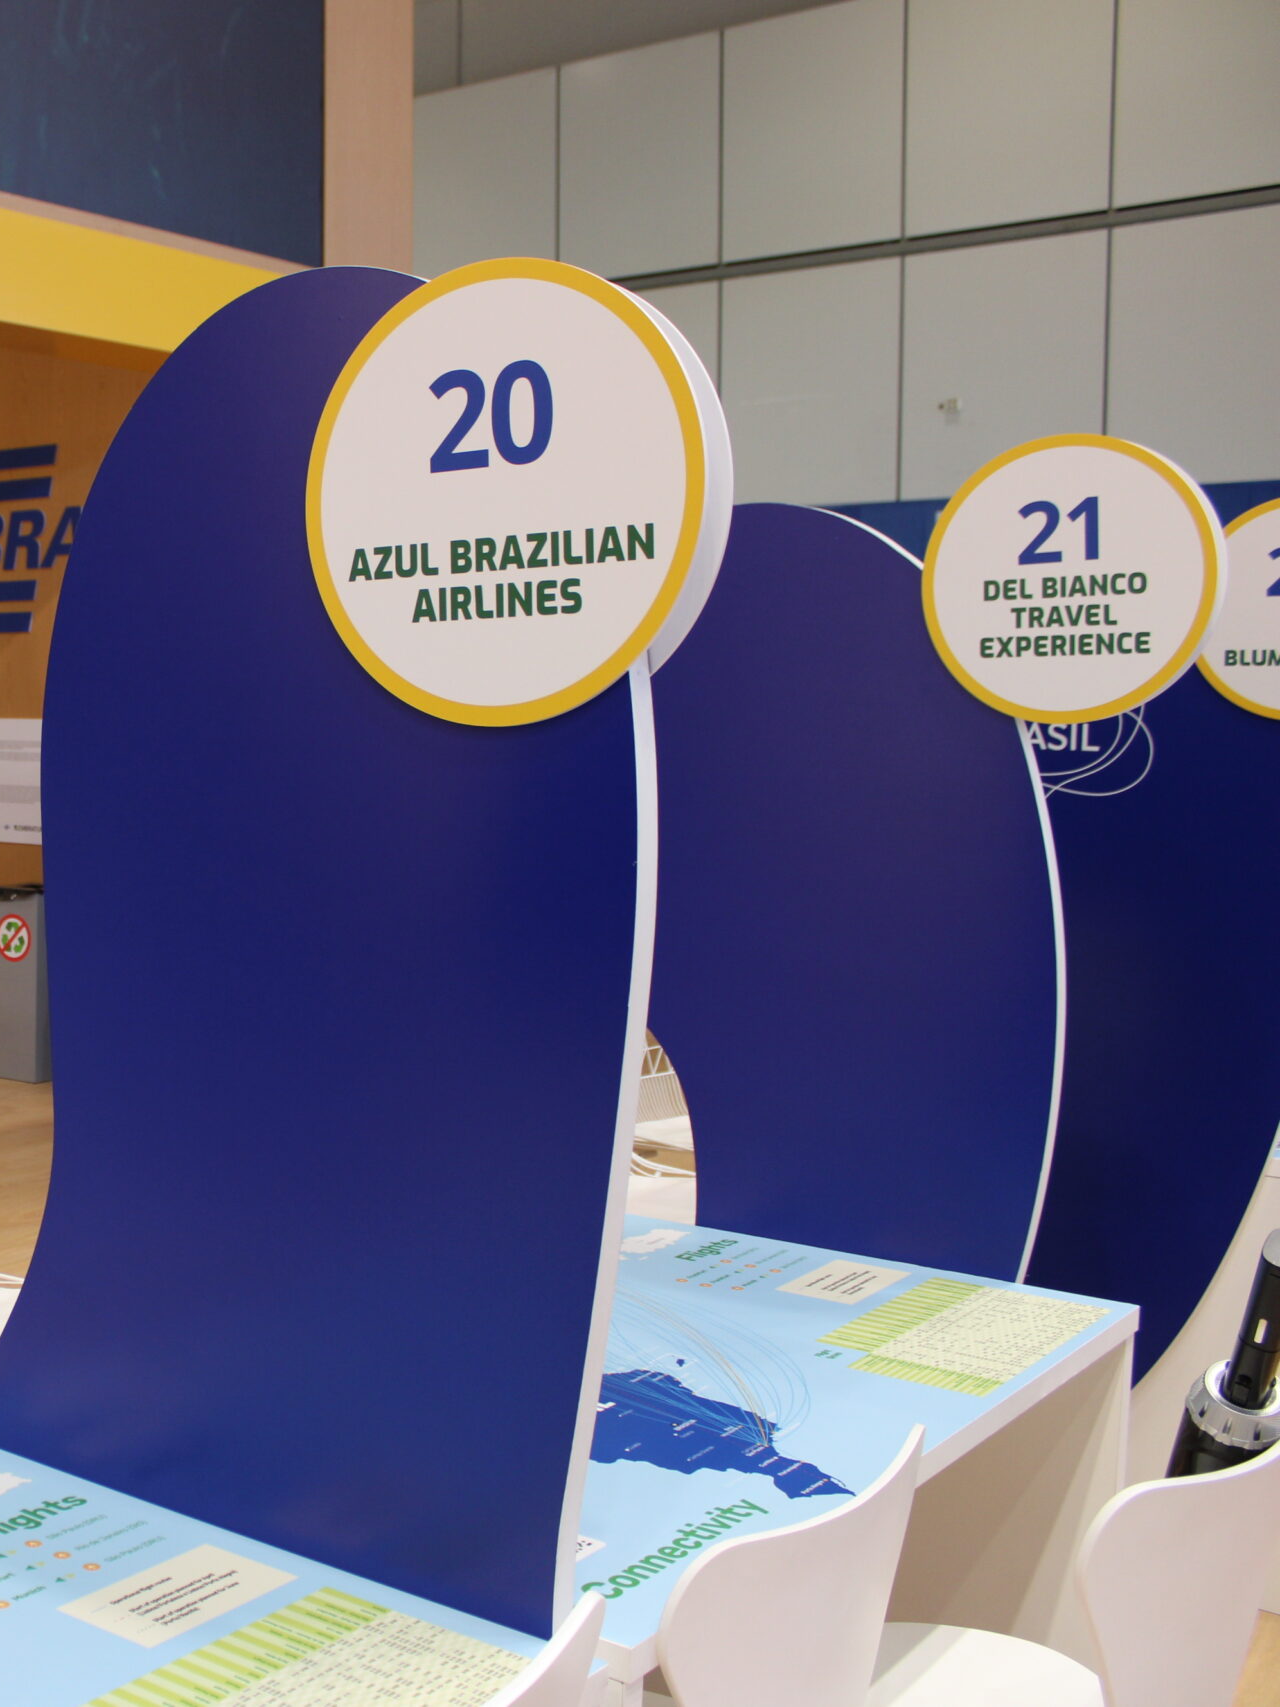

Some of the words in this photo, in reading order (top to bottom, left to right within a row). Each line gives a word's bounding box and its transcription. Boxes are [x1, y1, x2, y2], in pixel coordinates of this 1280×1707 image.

[429, 359, 554, 474] 20
[348, 543, 439, 582] AZUL
[449, 522, 656, 575] BRAZILIAN
[1017, 495, 1100, 566] 21
[411, 577, 583, 623] AIRLINES
[983, 578, 1034, 602] DEL
[1041, 571, 1148, 600] BIANCO
[1011, 603, 1118, 629] TRAVEL
[979, 631, 1151, 659] EXPERIENCE
[675, 1238, 739, 1262] Flights
[581, 1499, 769, 1599] Connectivity
